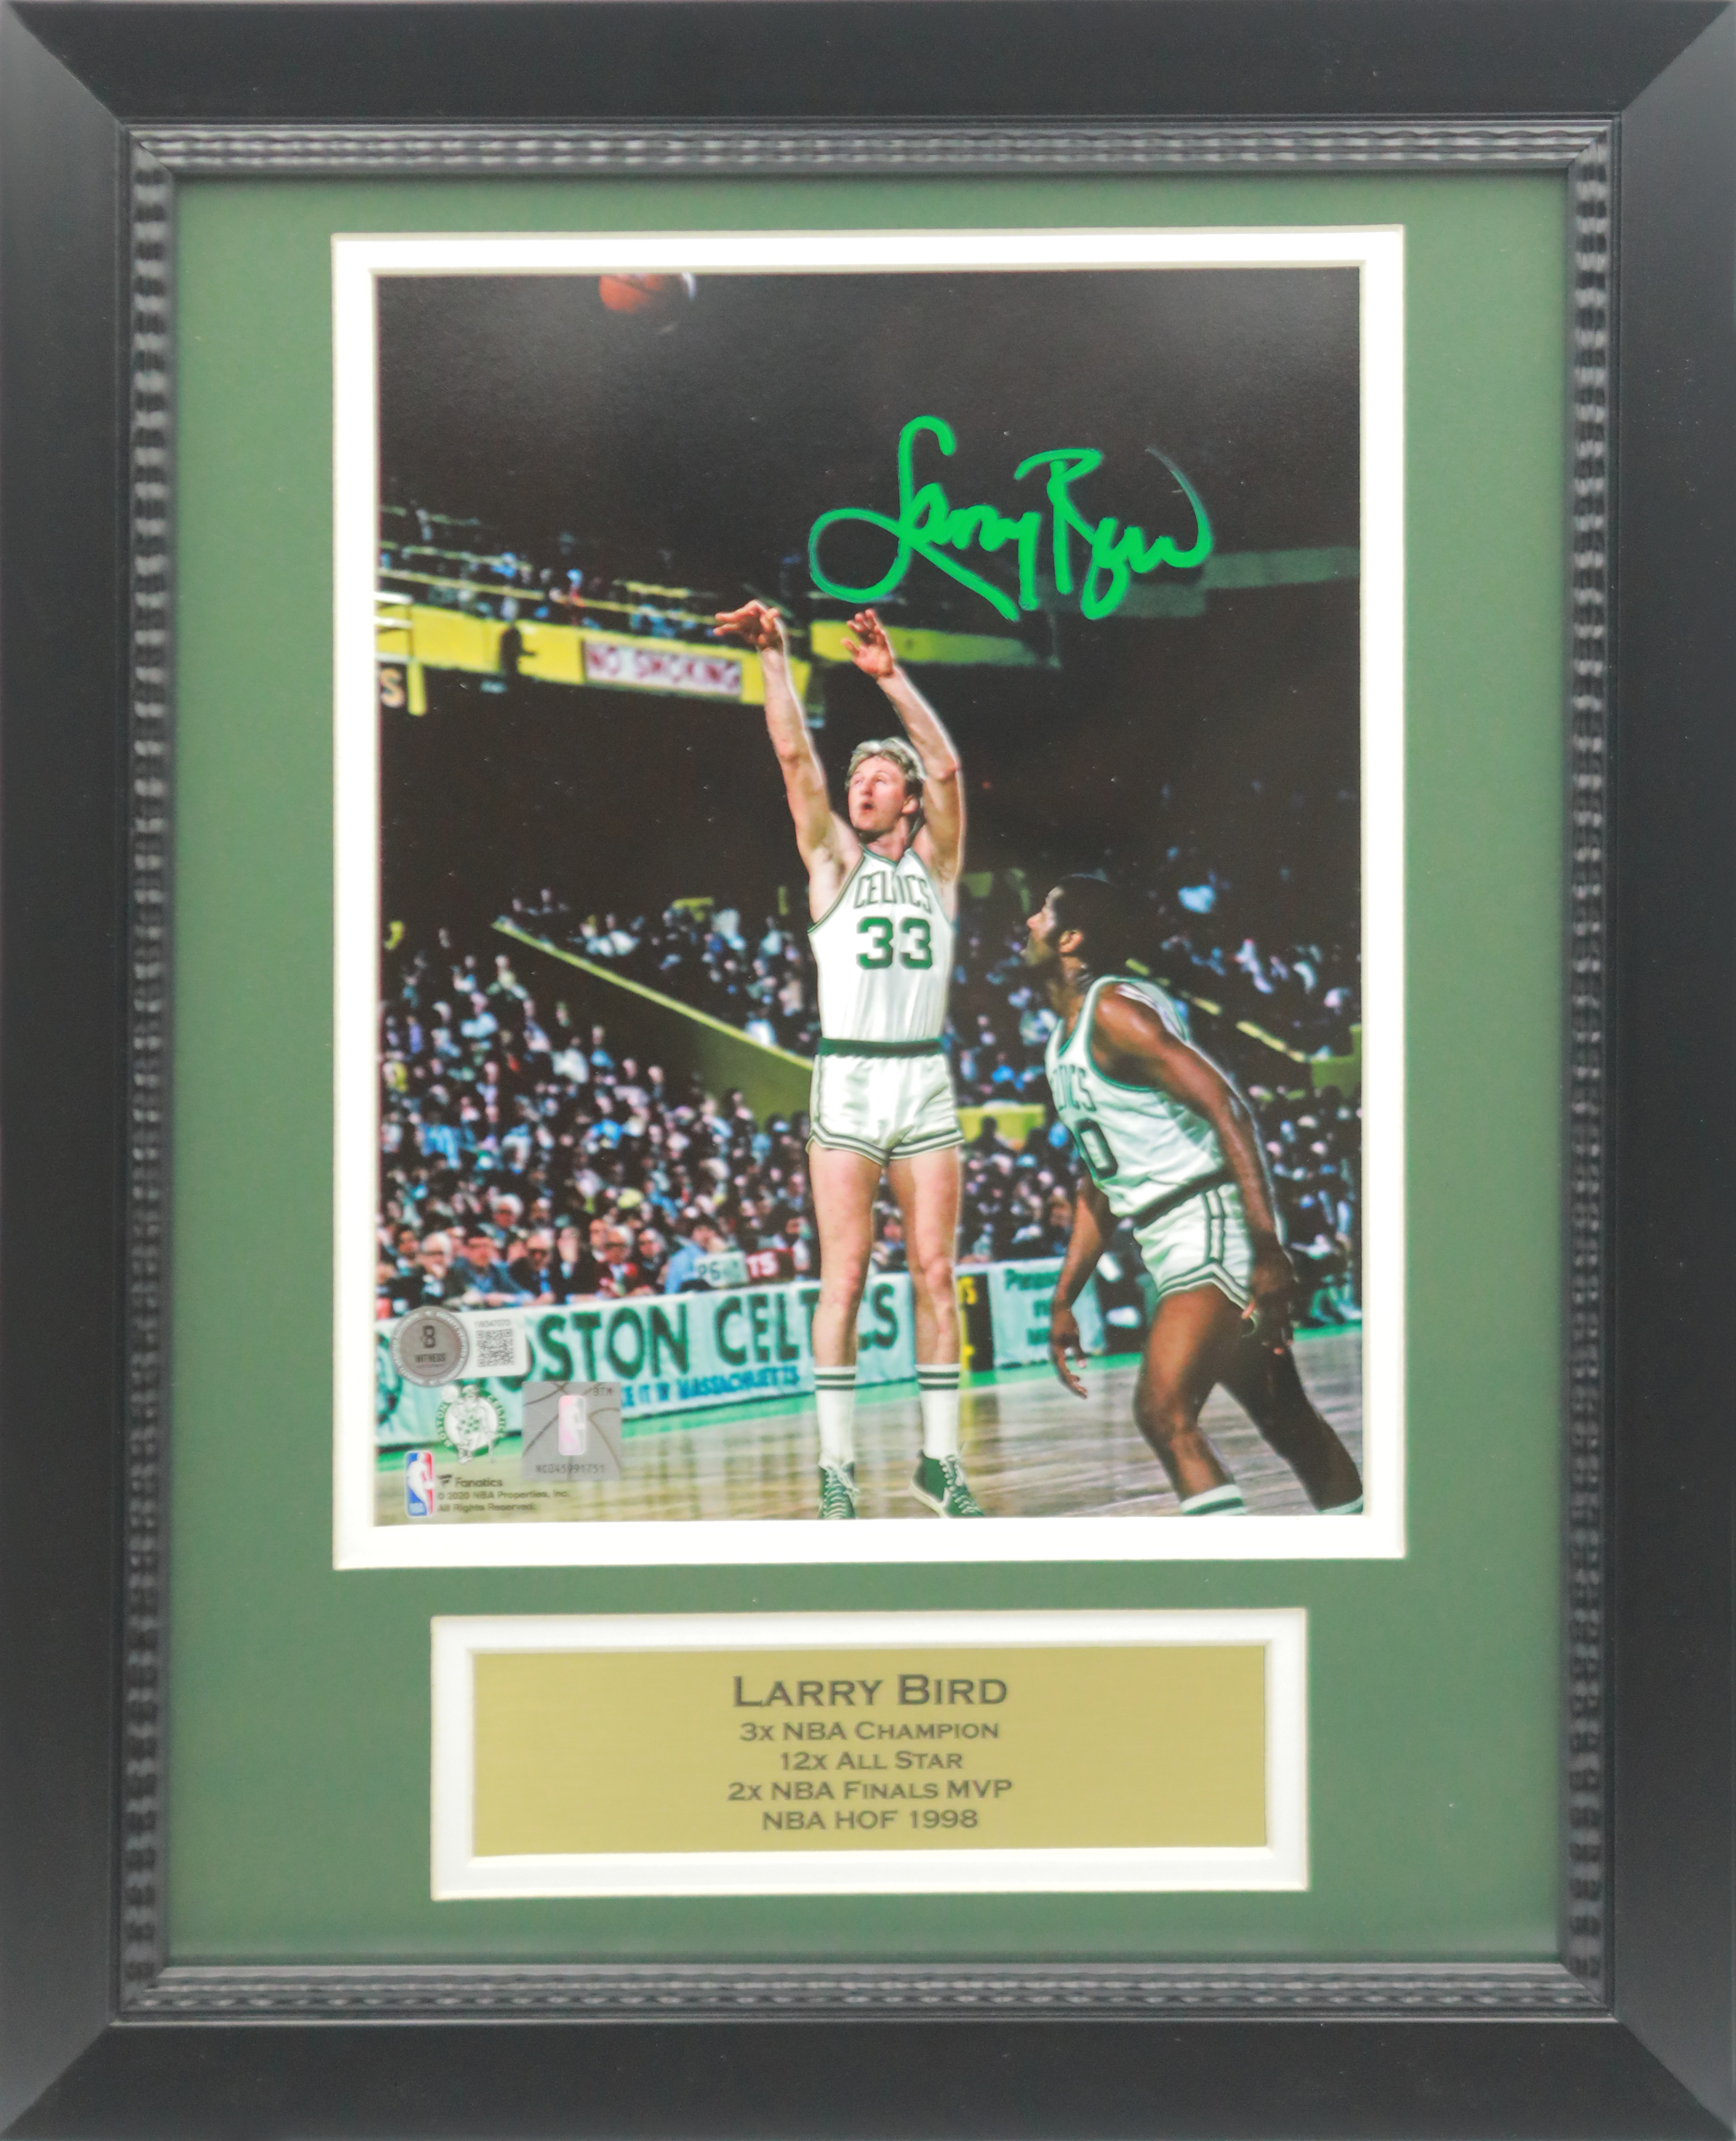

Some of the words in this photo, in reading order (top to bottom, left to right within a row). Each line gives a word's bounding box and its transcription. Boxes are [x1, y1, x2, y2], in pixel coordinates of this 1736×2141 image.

[853, 871, 932, 914] CELTICS
[856, 915, 933, 970] 33
[495, 1303, 690, 1391] STON
[715, 1283, 898, 1366] CELTS
[455, 1477, 503, 1488] Fanatics
[782, 1722, 846, 1740] NBA
[770, 1780, 835, 1800] NBA
[946, 1778, 1013, 1798] MVP
[761, 1811, 827, 1831] NBA
[834, 1810, 899, 1829] HOF
[910, 1809, 978, 1829] 1998
